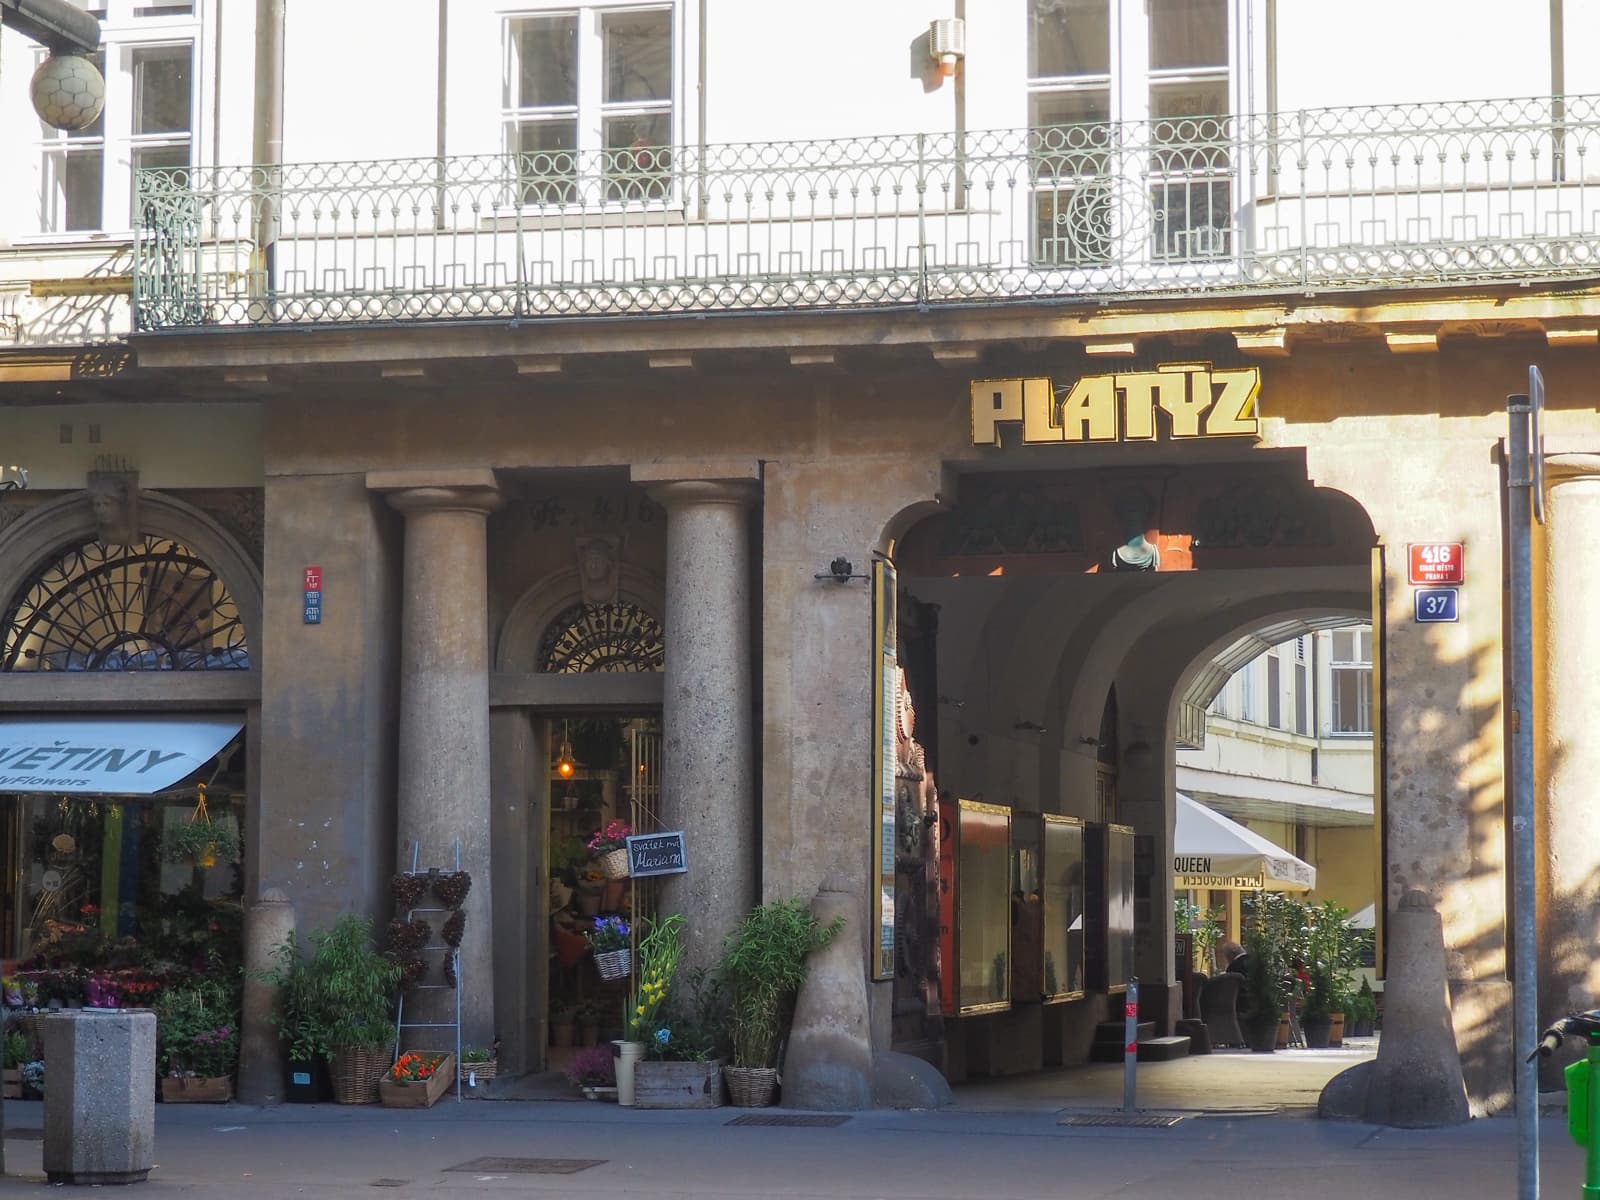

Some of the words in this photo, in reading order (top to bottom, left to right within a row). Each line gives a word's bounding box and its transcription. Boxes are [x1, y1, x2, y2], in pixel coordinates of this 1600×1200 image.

[1421, 545, 1451, 564] 416
[1426, 596, 1448, 614] 37
[1174, 856, 1211, 873] QUEEN
